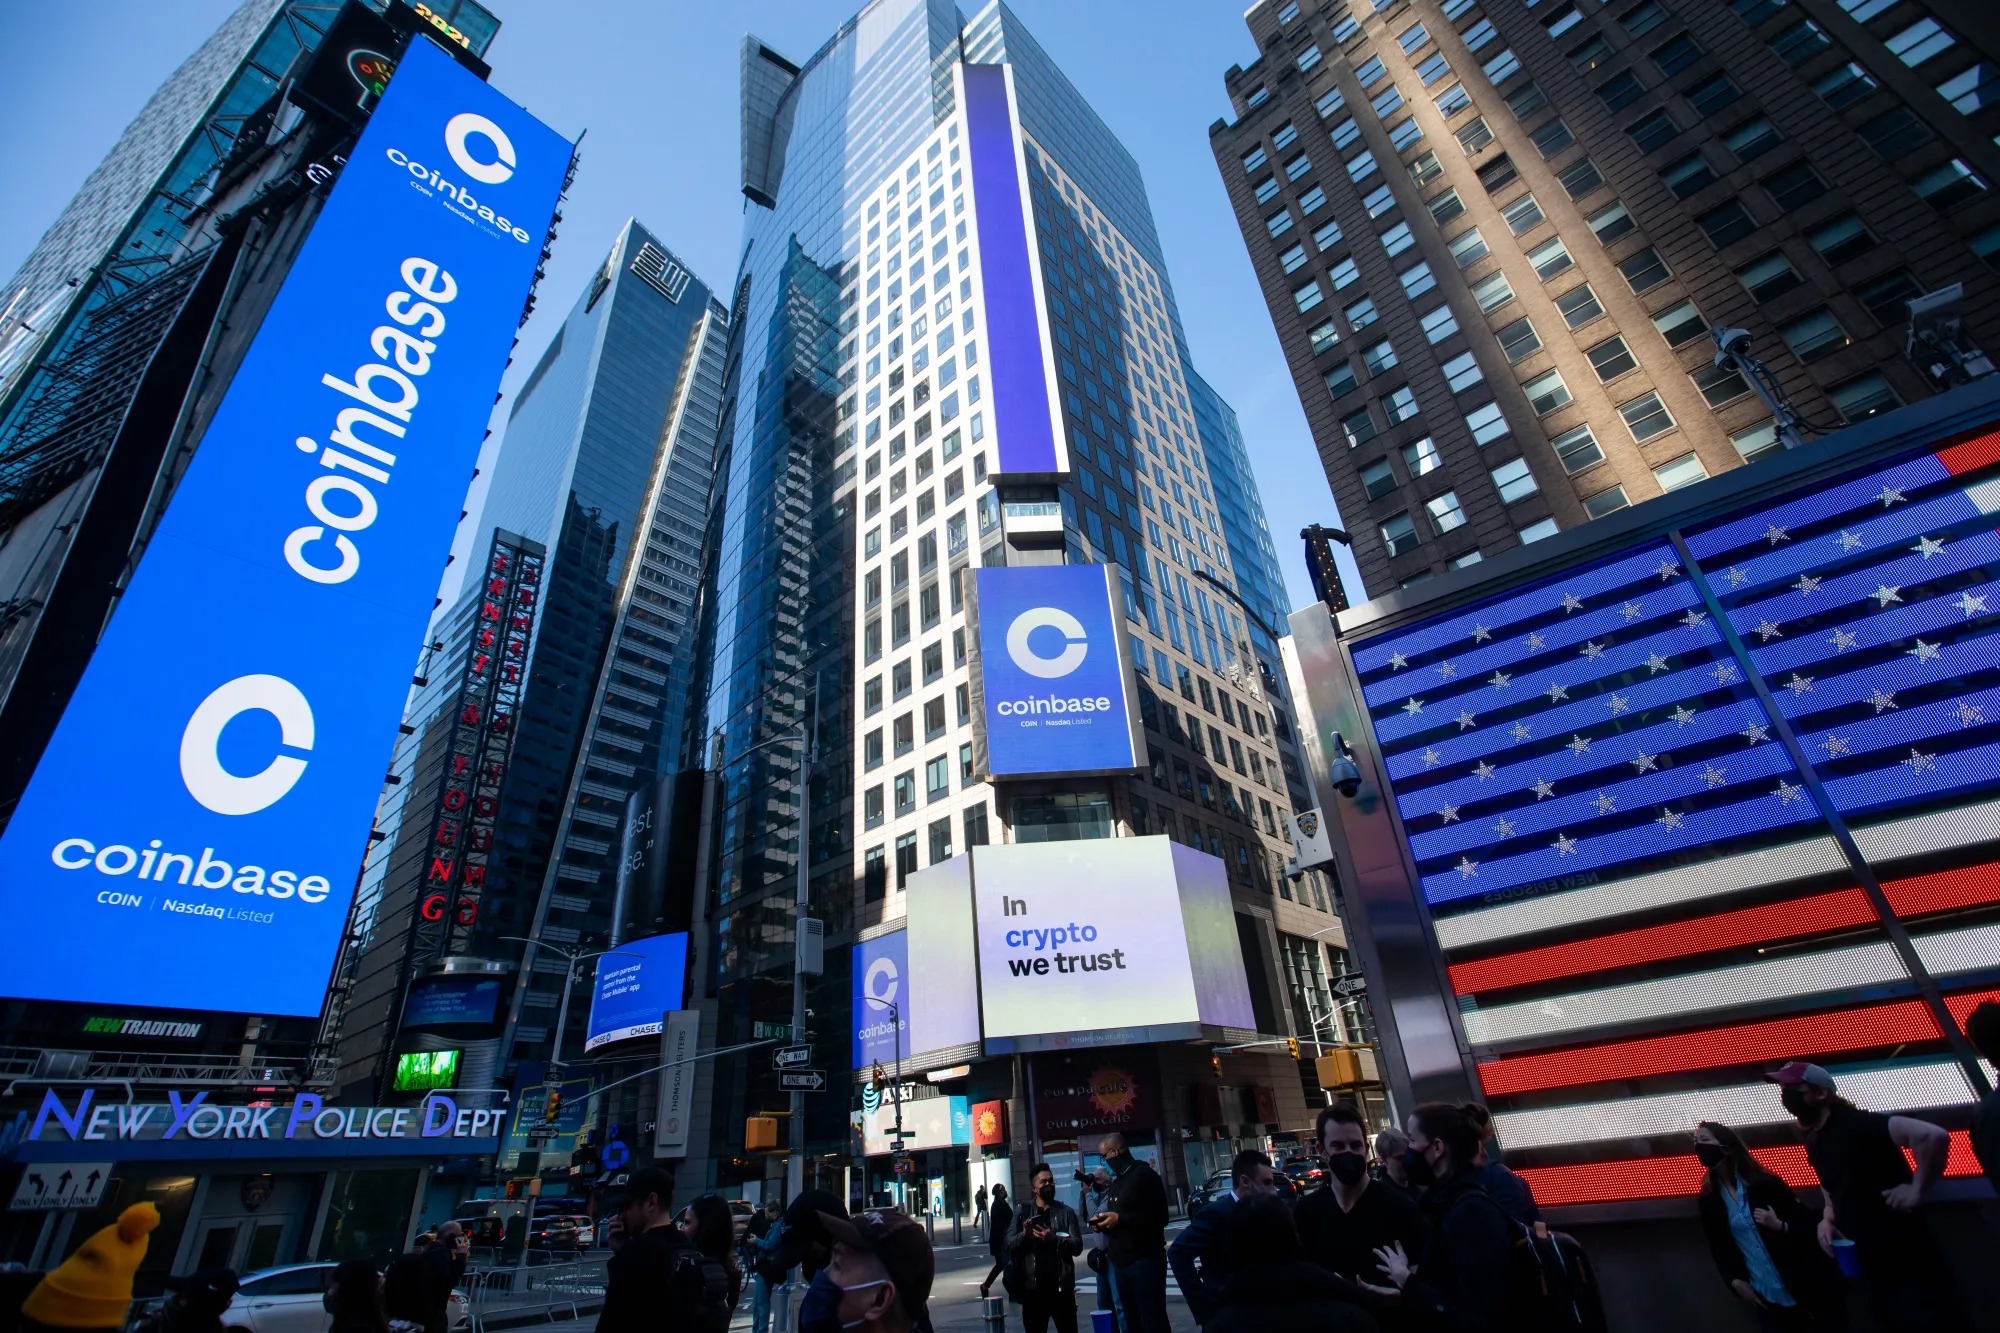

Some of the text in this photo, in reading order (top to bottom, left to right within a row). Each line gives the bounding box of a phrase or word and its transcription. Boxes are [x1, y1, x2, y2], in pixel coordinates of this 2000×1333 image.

[386, 148, 530, 244] coinbase
[410, 181, 433, 198] COIN
[443, 201, 475, 225] Nasdaq
[284, 257, 458, 584] coinbase
[998, 694, 1111, 717] coinbase
[1020, 717, 1092, 728] COIN Nasdaq Listed
[421, 752, 471, 922] YOUNG
[52, 839, 330, 905] coinbase
[97, 891, 275, 924] COIN Nasdaq Listed
[1002, 895, 1027, 917] In
[1006, 922, 1098, 958] crypto
[619, 963, 641, 977] parental
[1008, 947, 1126, 977] we trust
[615, 977, 627, 986] from
[626, 974, 636, 983] the
[629, 983, 641, 993] app
[1339, 980, 1357, 992] ONE
[630, 1024, 656, 1036] CHASE
[764, 1024, 772, 1037] W
[775, 1026, 784, 1039] 43
[778, 1051, 806, 1063] ONE WAY
[670, 1068, 683, 1113] THOMSON
[786, 1075, 819, 1085] ONE WAY
[28, 1086, 156, 1141] NEW
[163, 1091, 279, 1139] YORK
[284, 1092, 410, 1139] POLICE
[14, 1195, 97, 1207] ONLY ONLY ONLY
